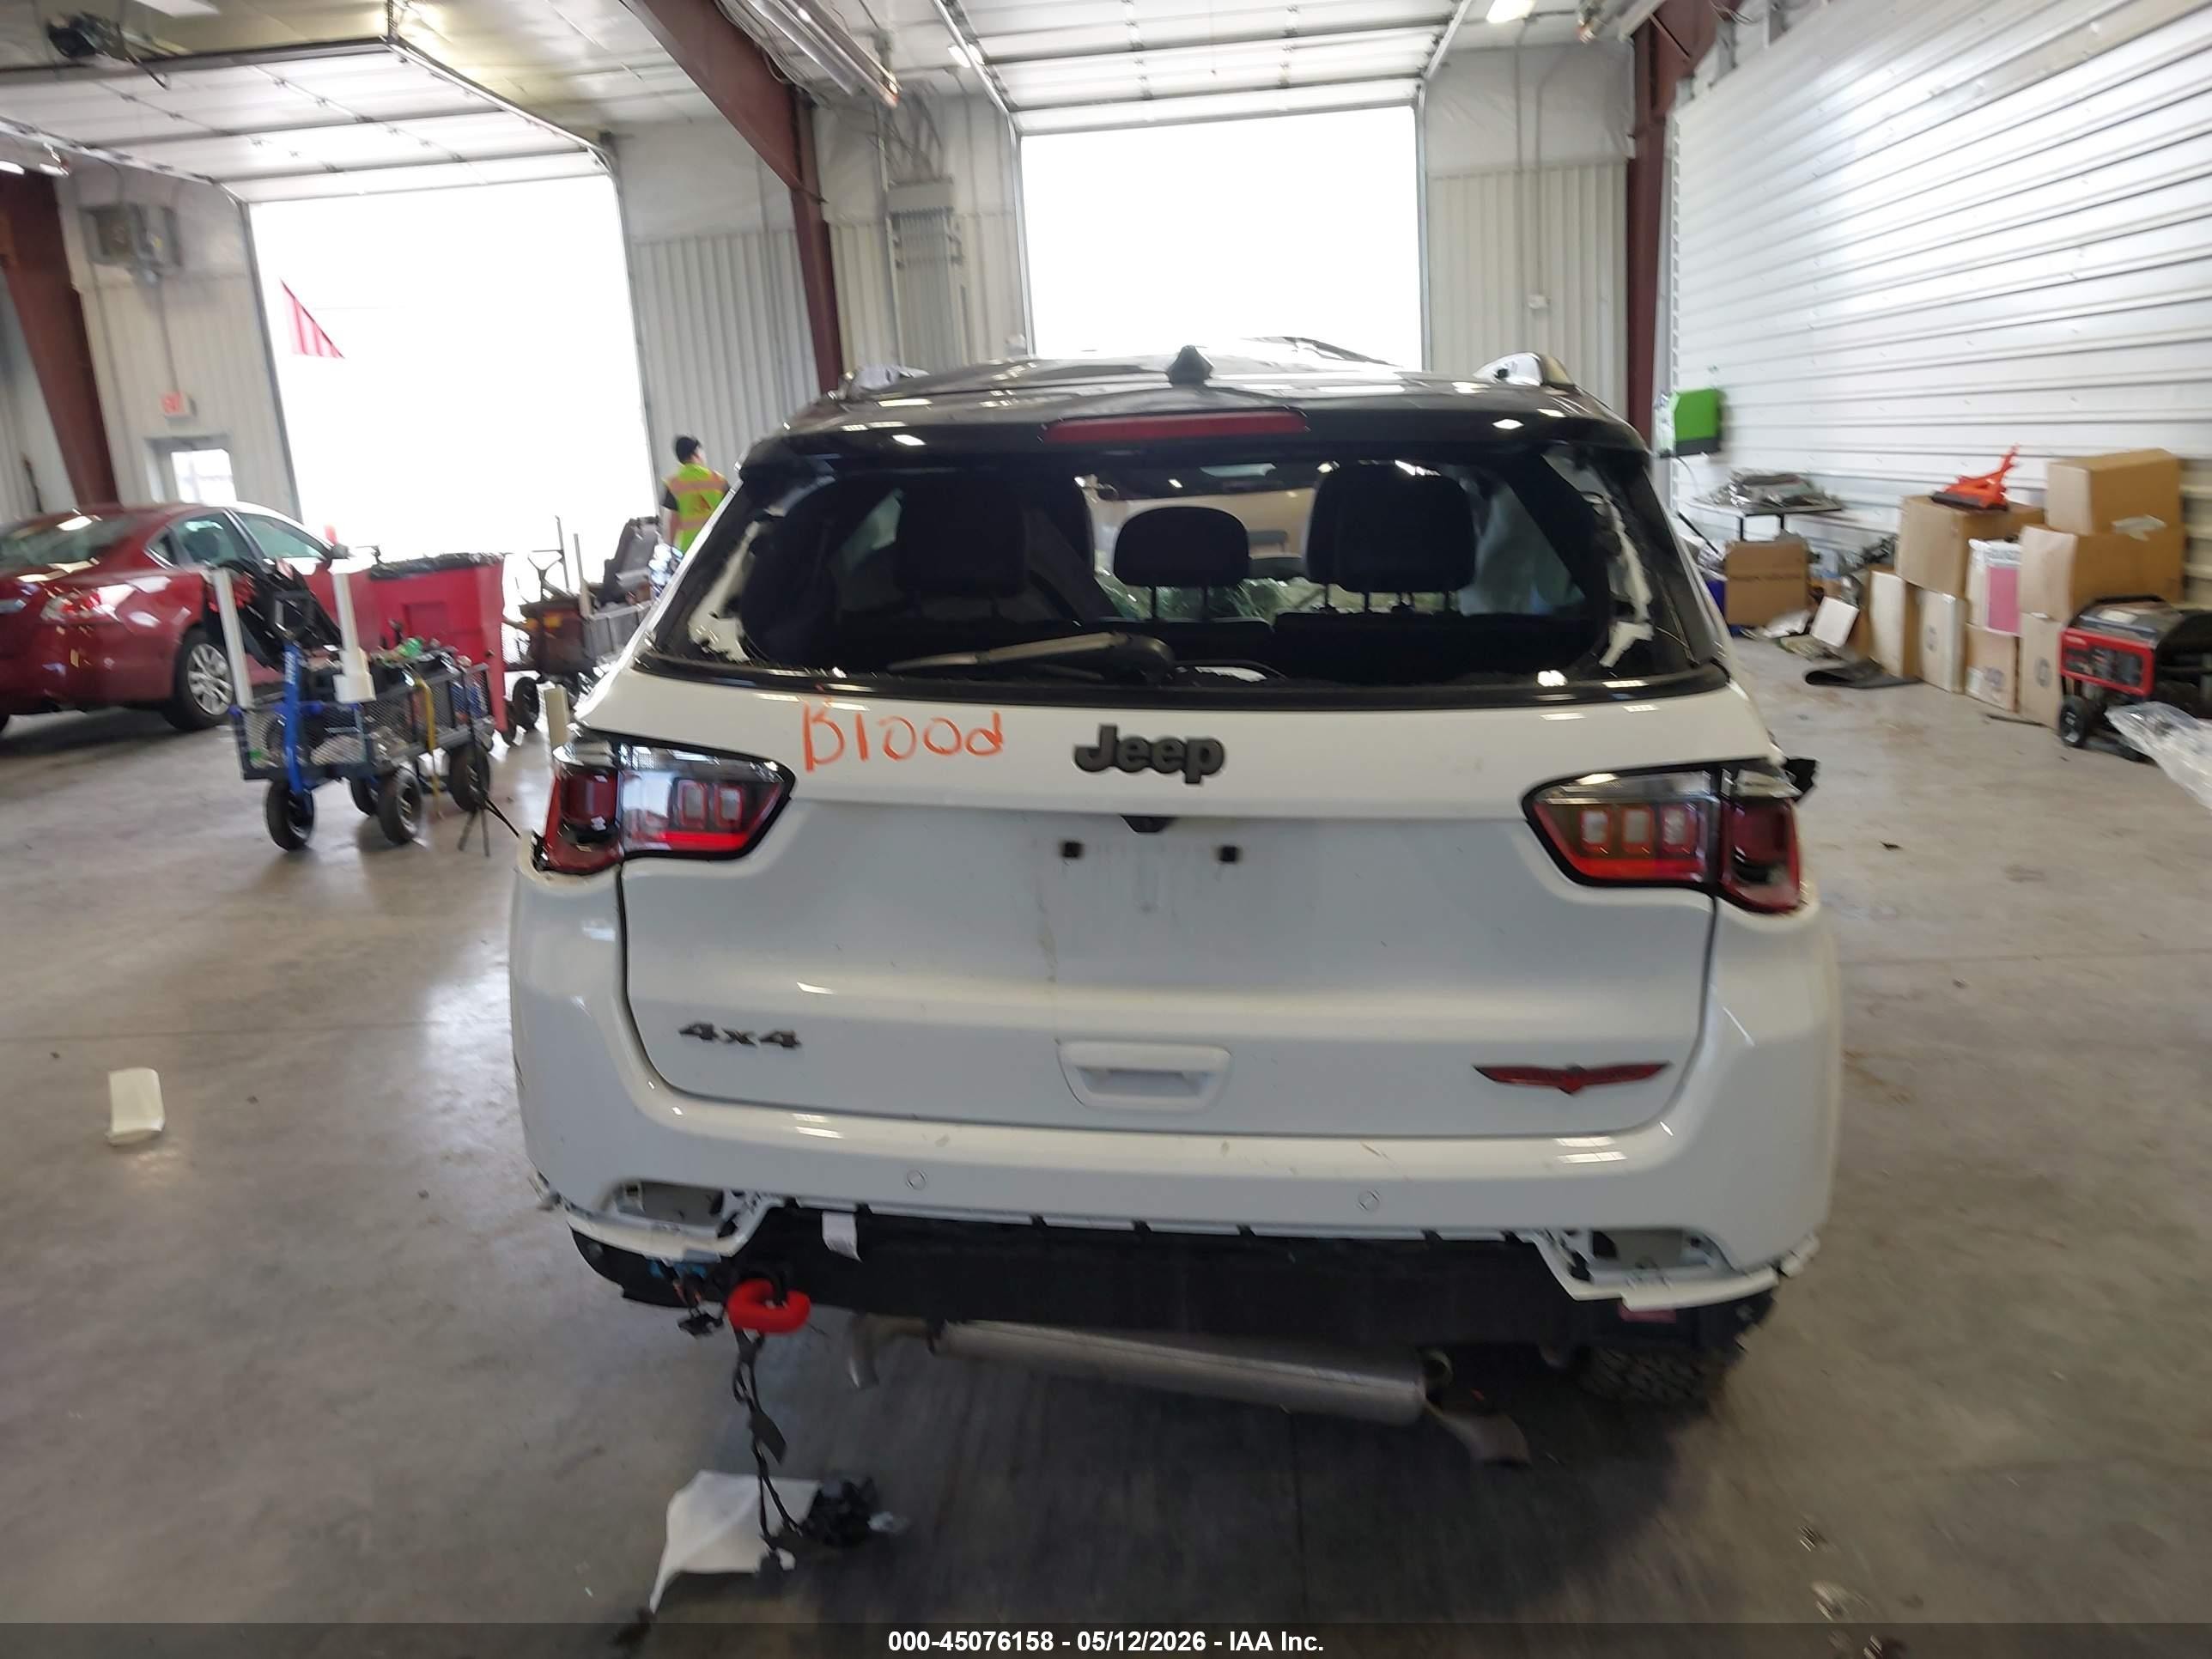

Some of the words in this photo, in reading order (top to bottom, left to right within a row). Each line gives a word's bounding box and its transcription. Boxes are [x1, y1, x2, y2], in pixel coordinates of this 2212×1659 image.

[802, 700, 1004, 773] Blood
[1073, 724, 1226, 786] Jeep
[678, 1022, 802, 1049] 4x4
